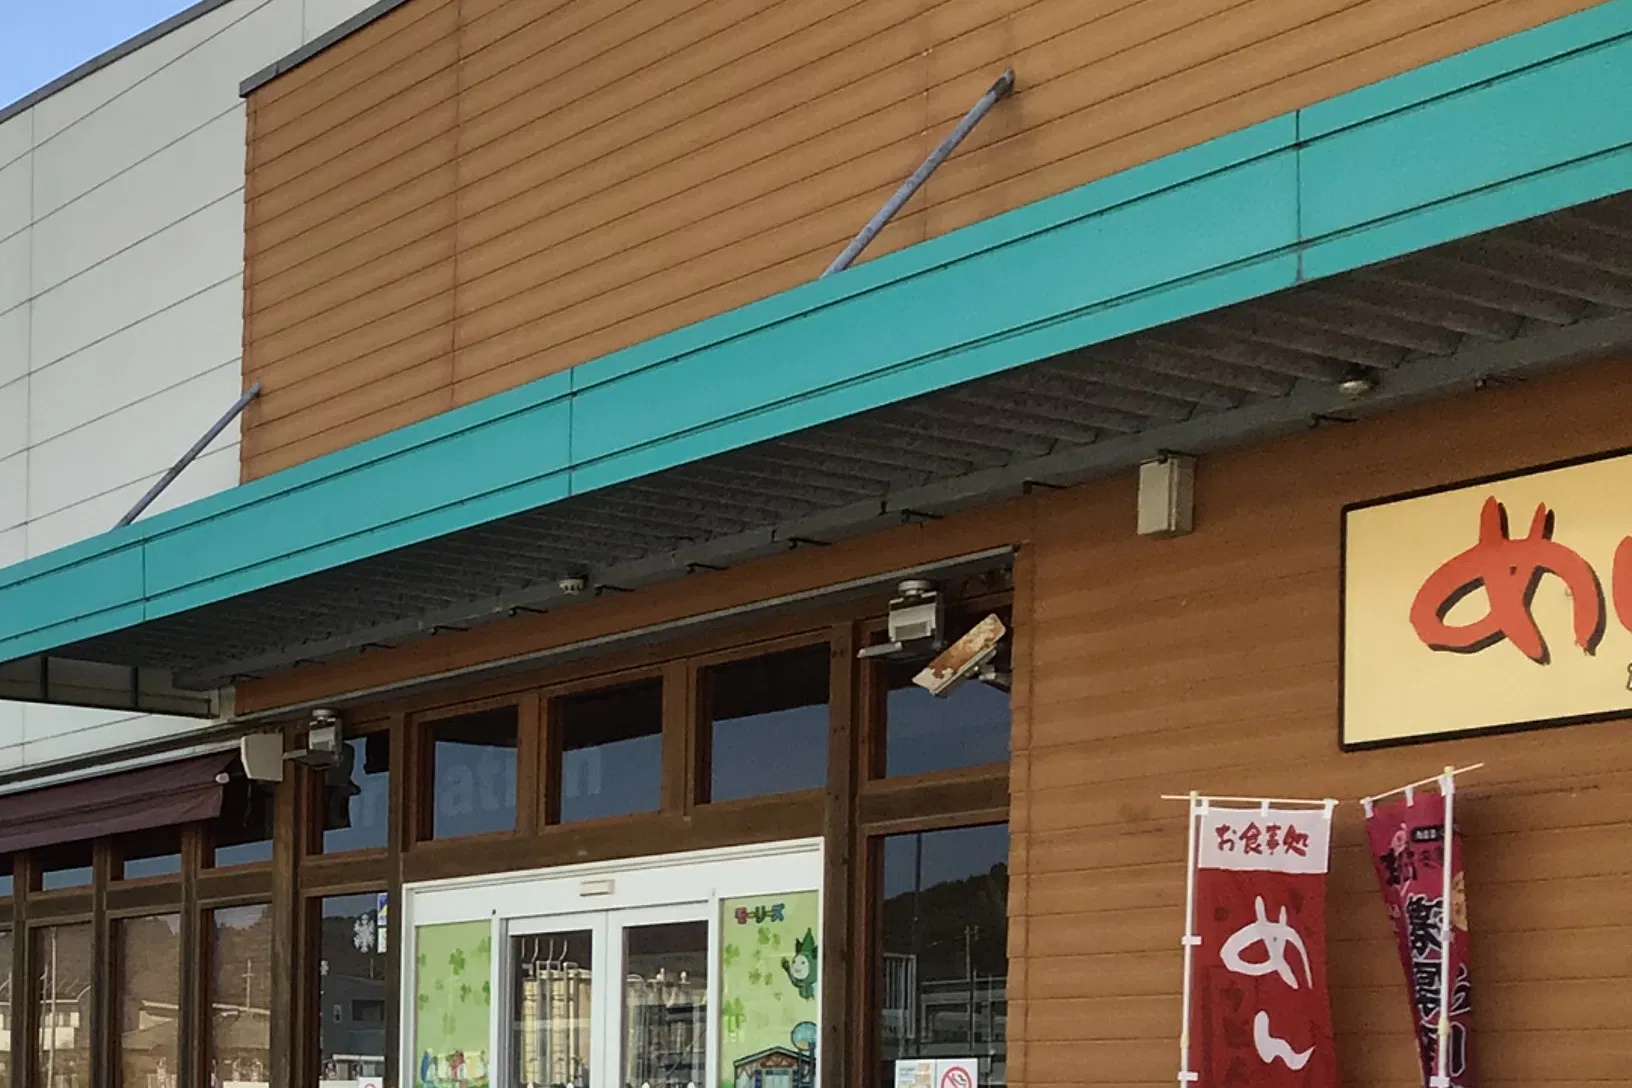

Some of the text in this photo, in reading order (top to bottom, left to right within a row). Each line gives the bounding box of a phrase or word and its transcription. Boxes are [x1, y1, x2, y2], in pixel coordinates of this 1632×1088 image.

[1409, 496, 1632, 665] め
[1215, 821, 1309, 857] お食事処
